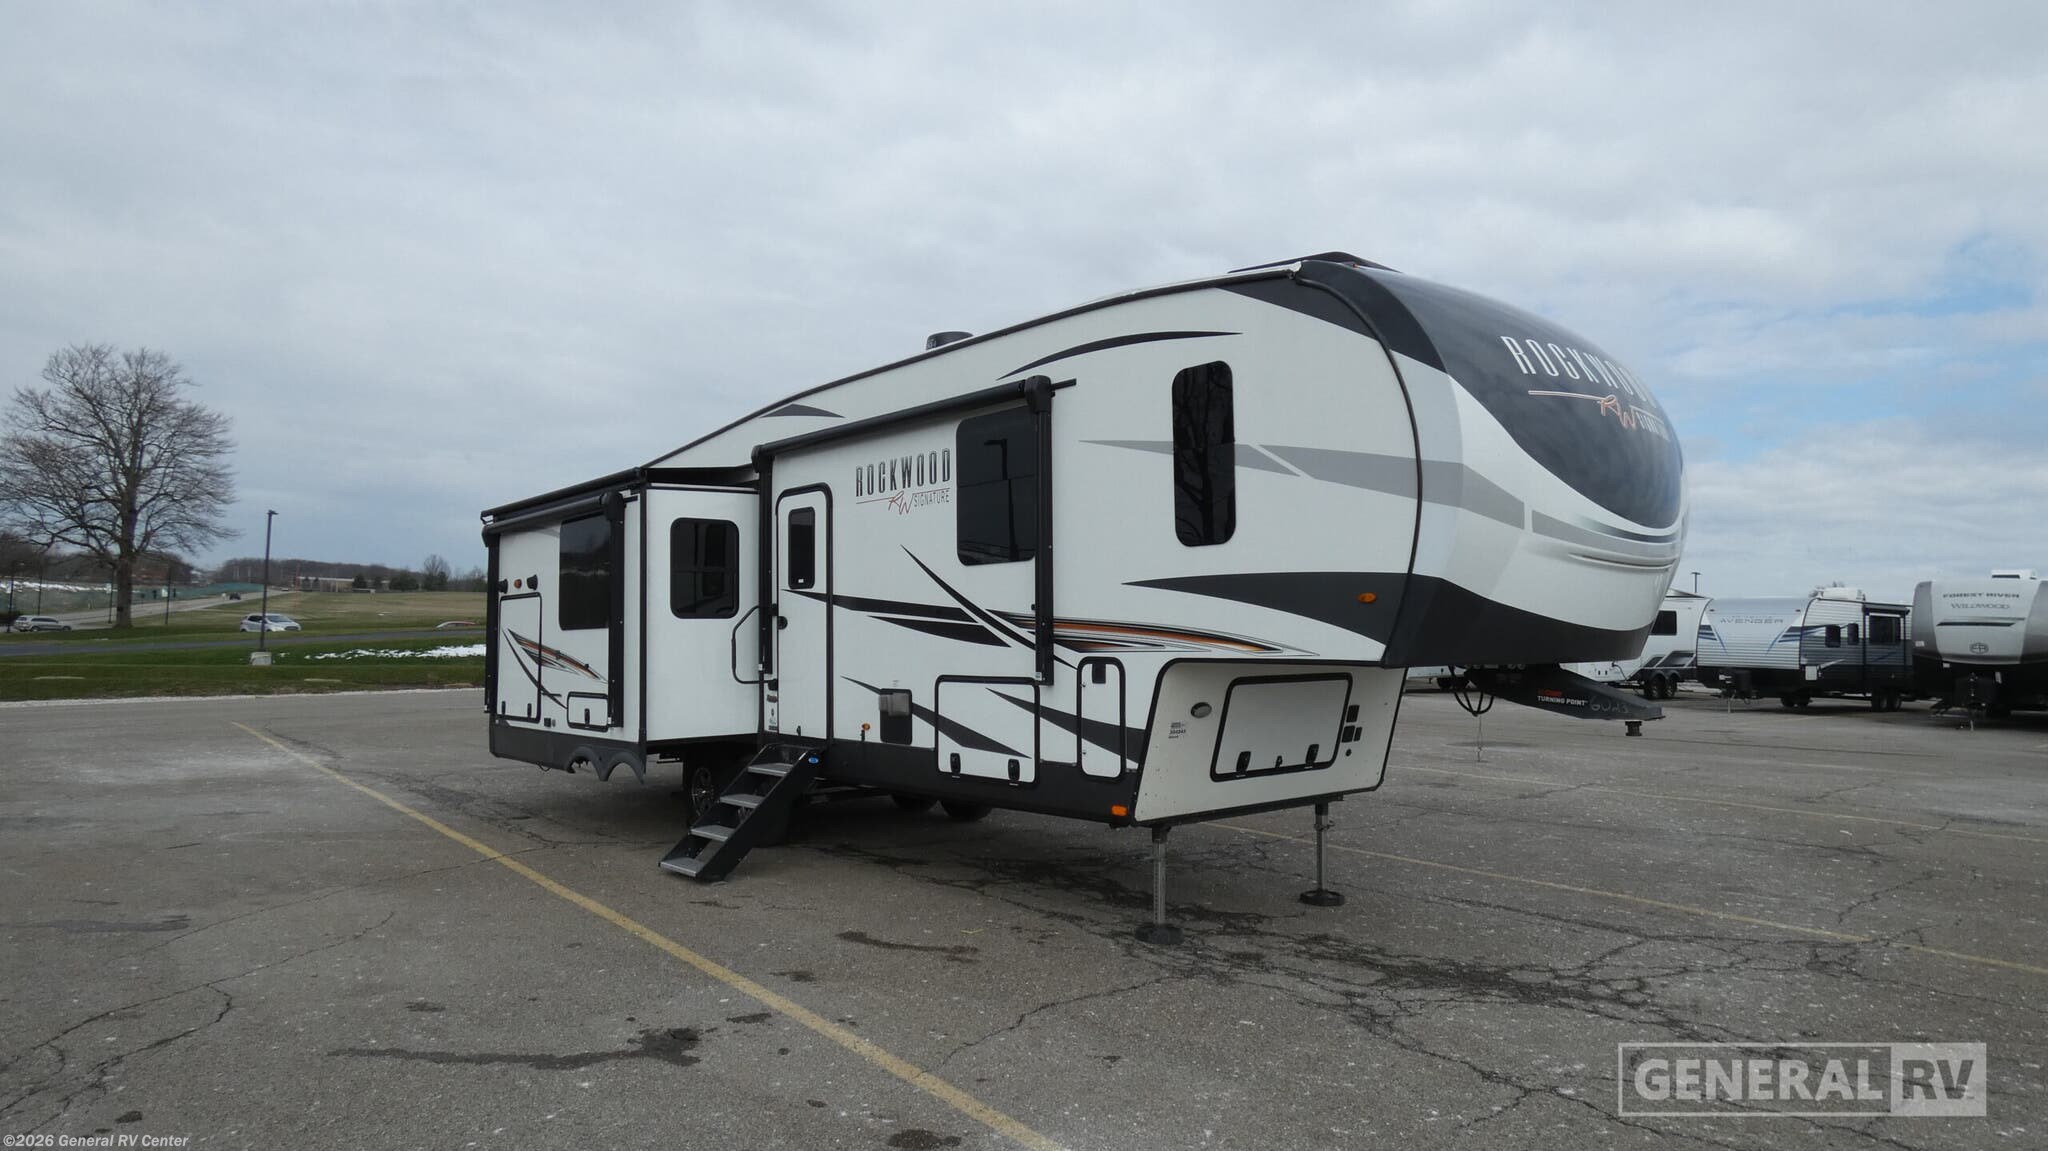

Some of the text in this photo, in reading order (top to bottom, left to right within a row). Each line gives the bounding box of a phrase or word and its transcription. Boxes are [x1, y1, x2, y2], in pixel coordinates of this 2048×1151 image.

[856, 448, 950, 497] ROCKWOOD
[913, 489, 950, 507] SIGNATURE
[1537, 695, 1585, 706] TURNING POINT
